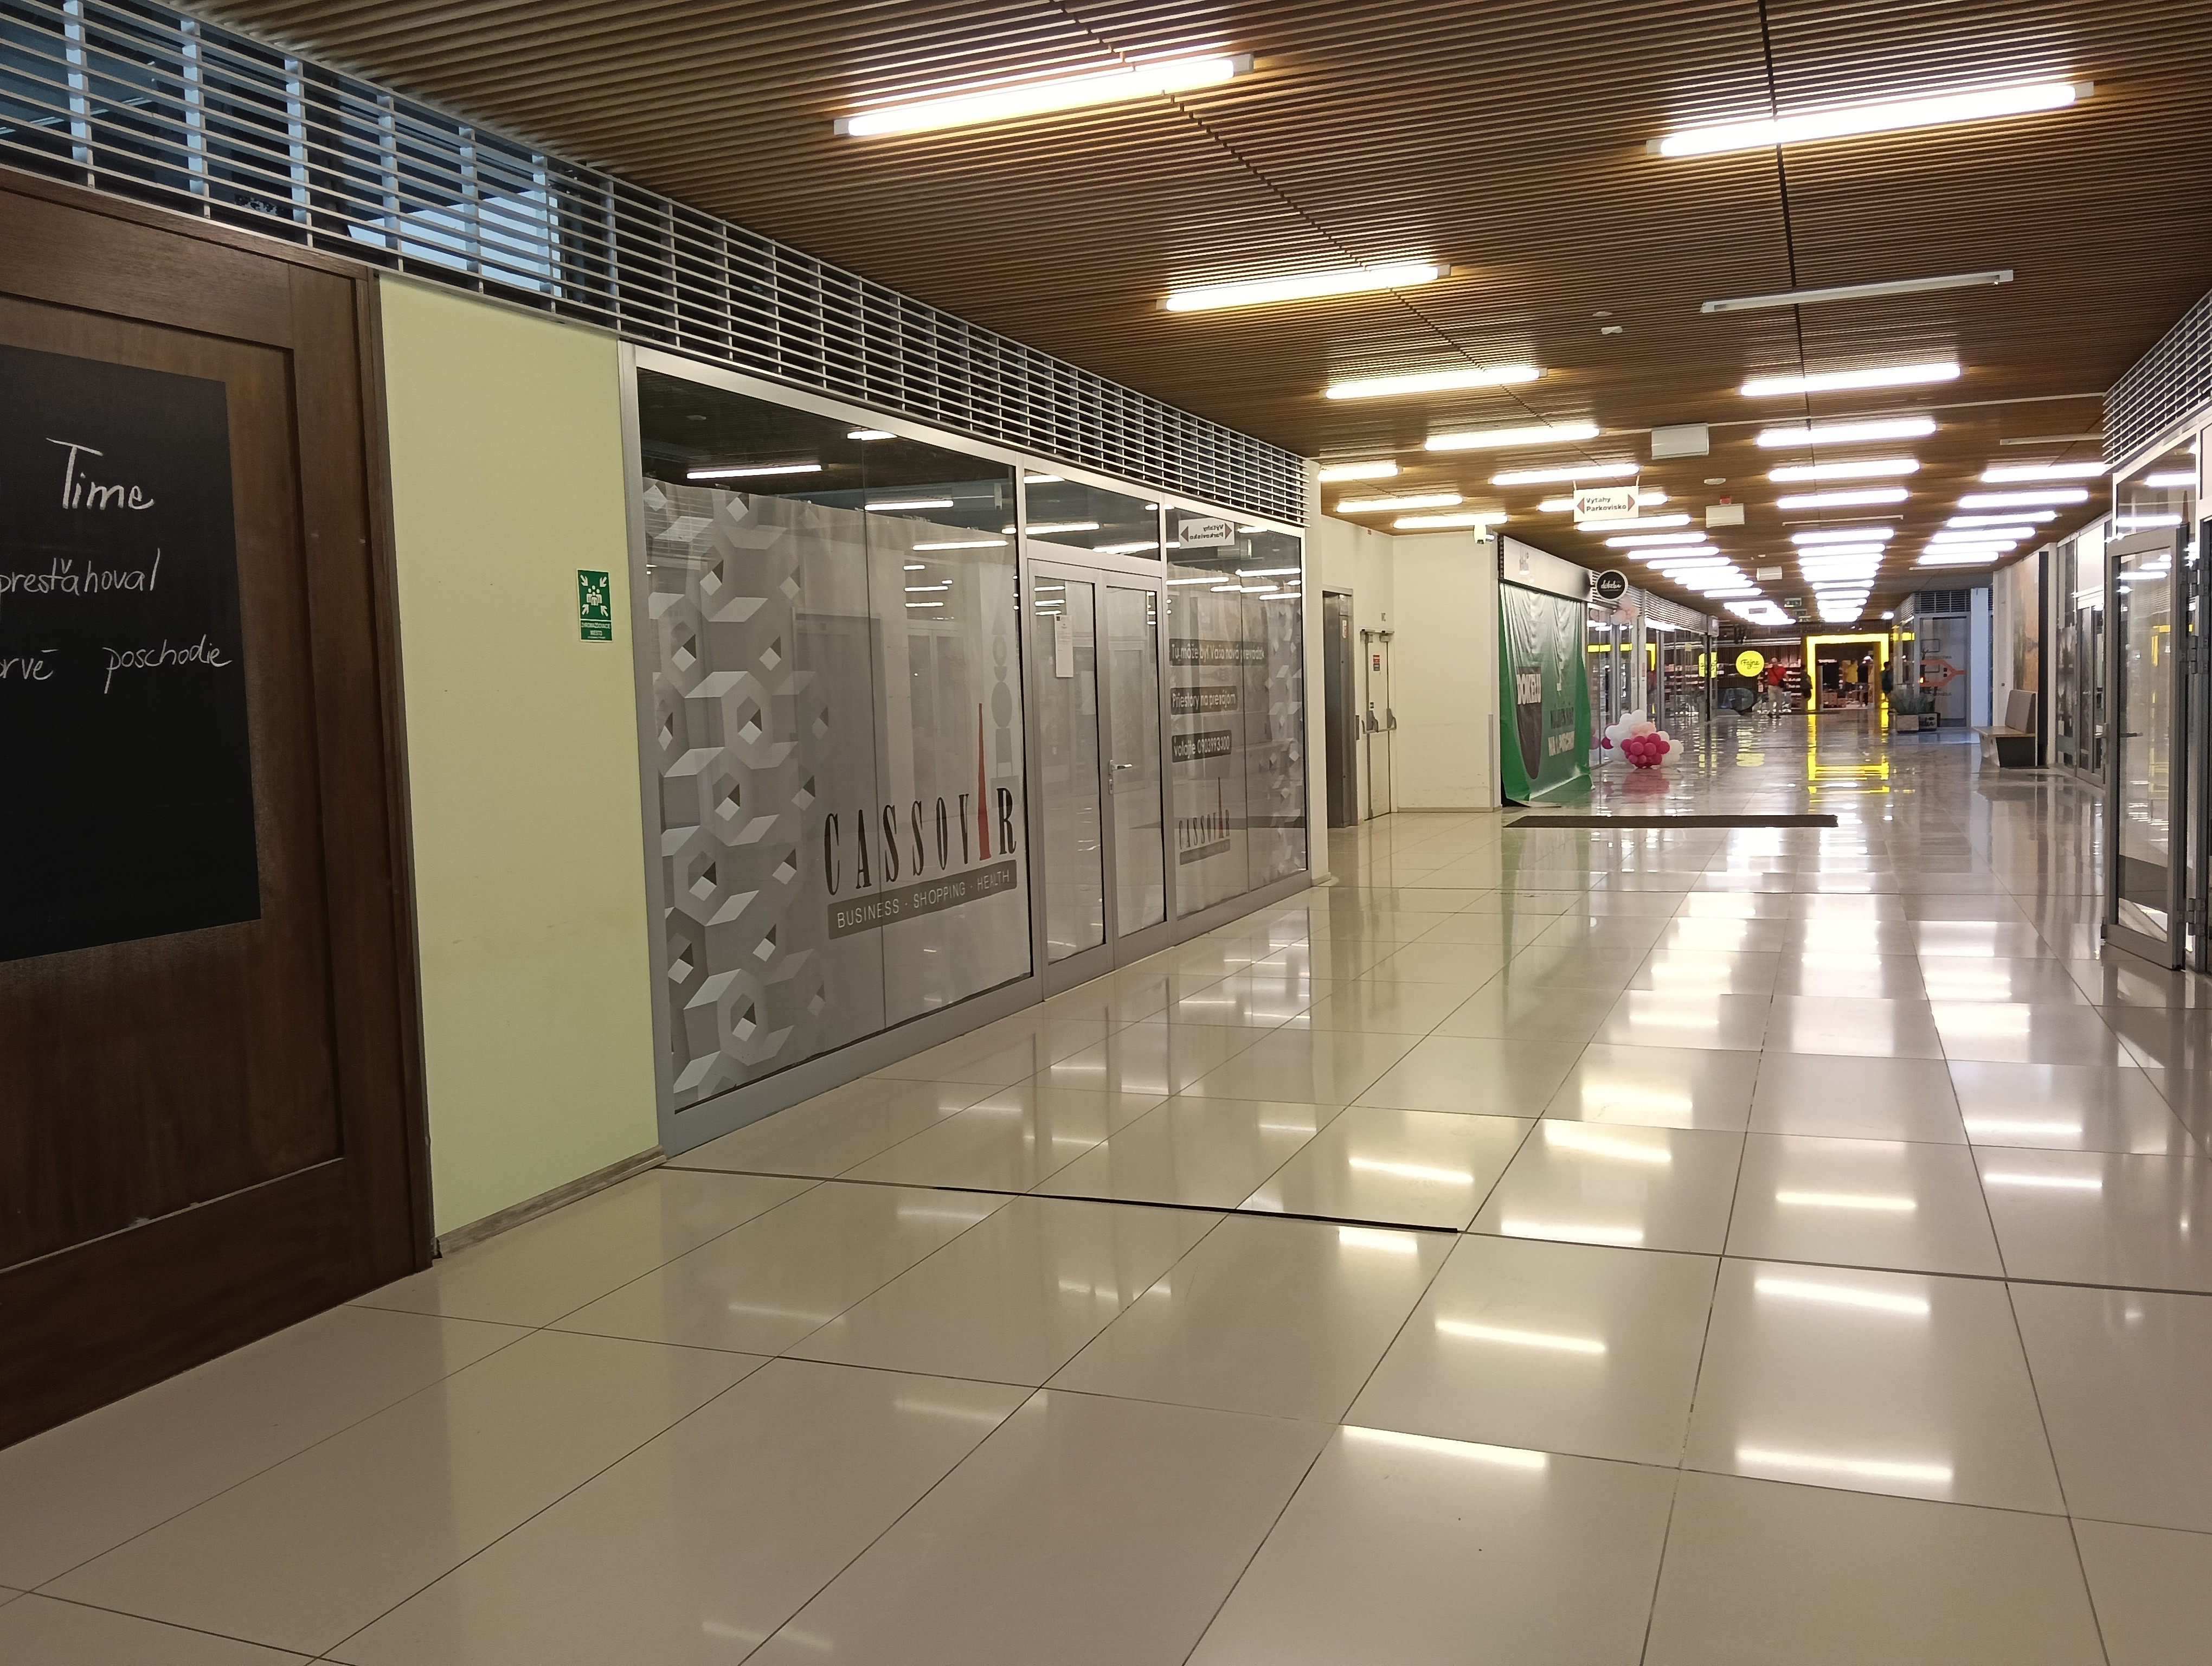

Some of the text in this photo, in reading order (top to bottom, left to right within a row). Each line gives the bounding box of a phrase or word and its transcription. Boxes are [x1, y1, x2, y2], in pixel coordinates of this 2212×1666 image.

[46, 437, 155, 510] Time
[101, 633, 233, 694] poschodie
[1172, 692, 1199, 710] Priestory
[837, 869, 1010, 928] BUSINESS SHOPPING HEALTH
